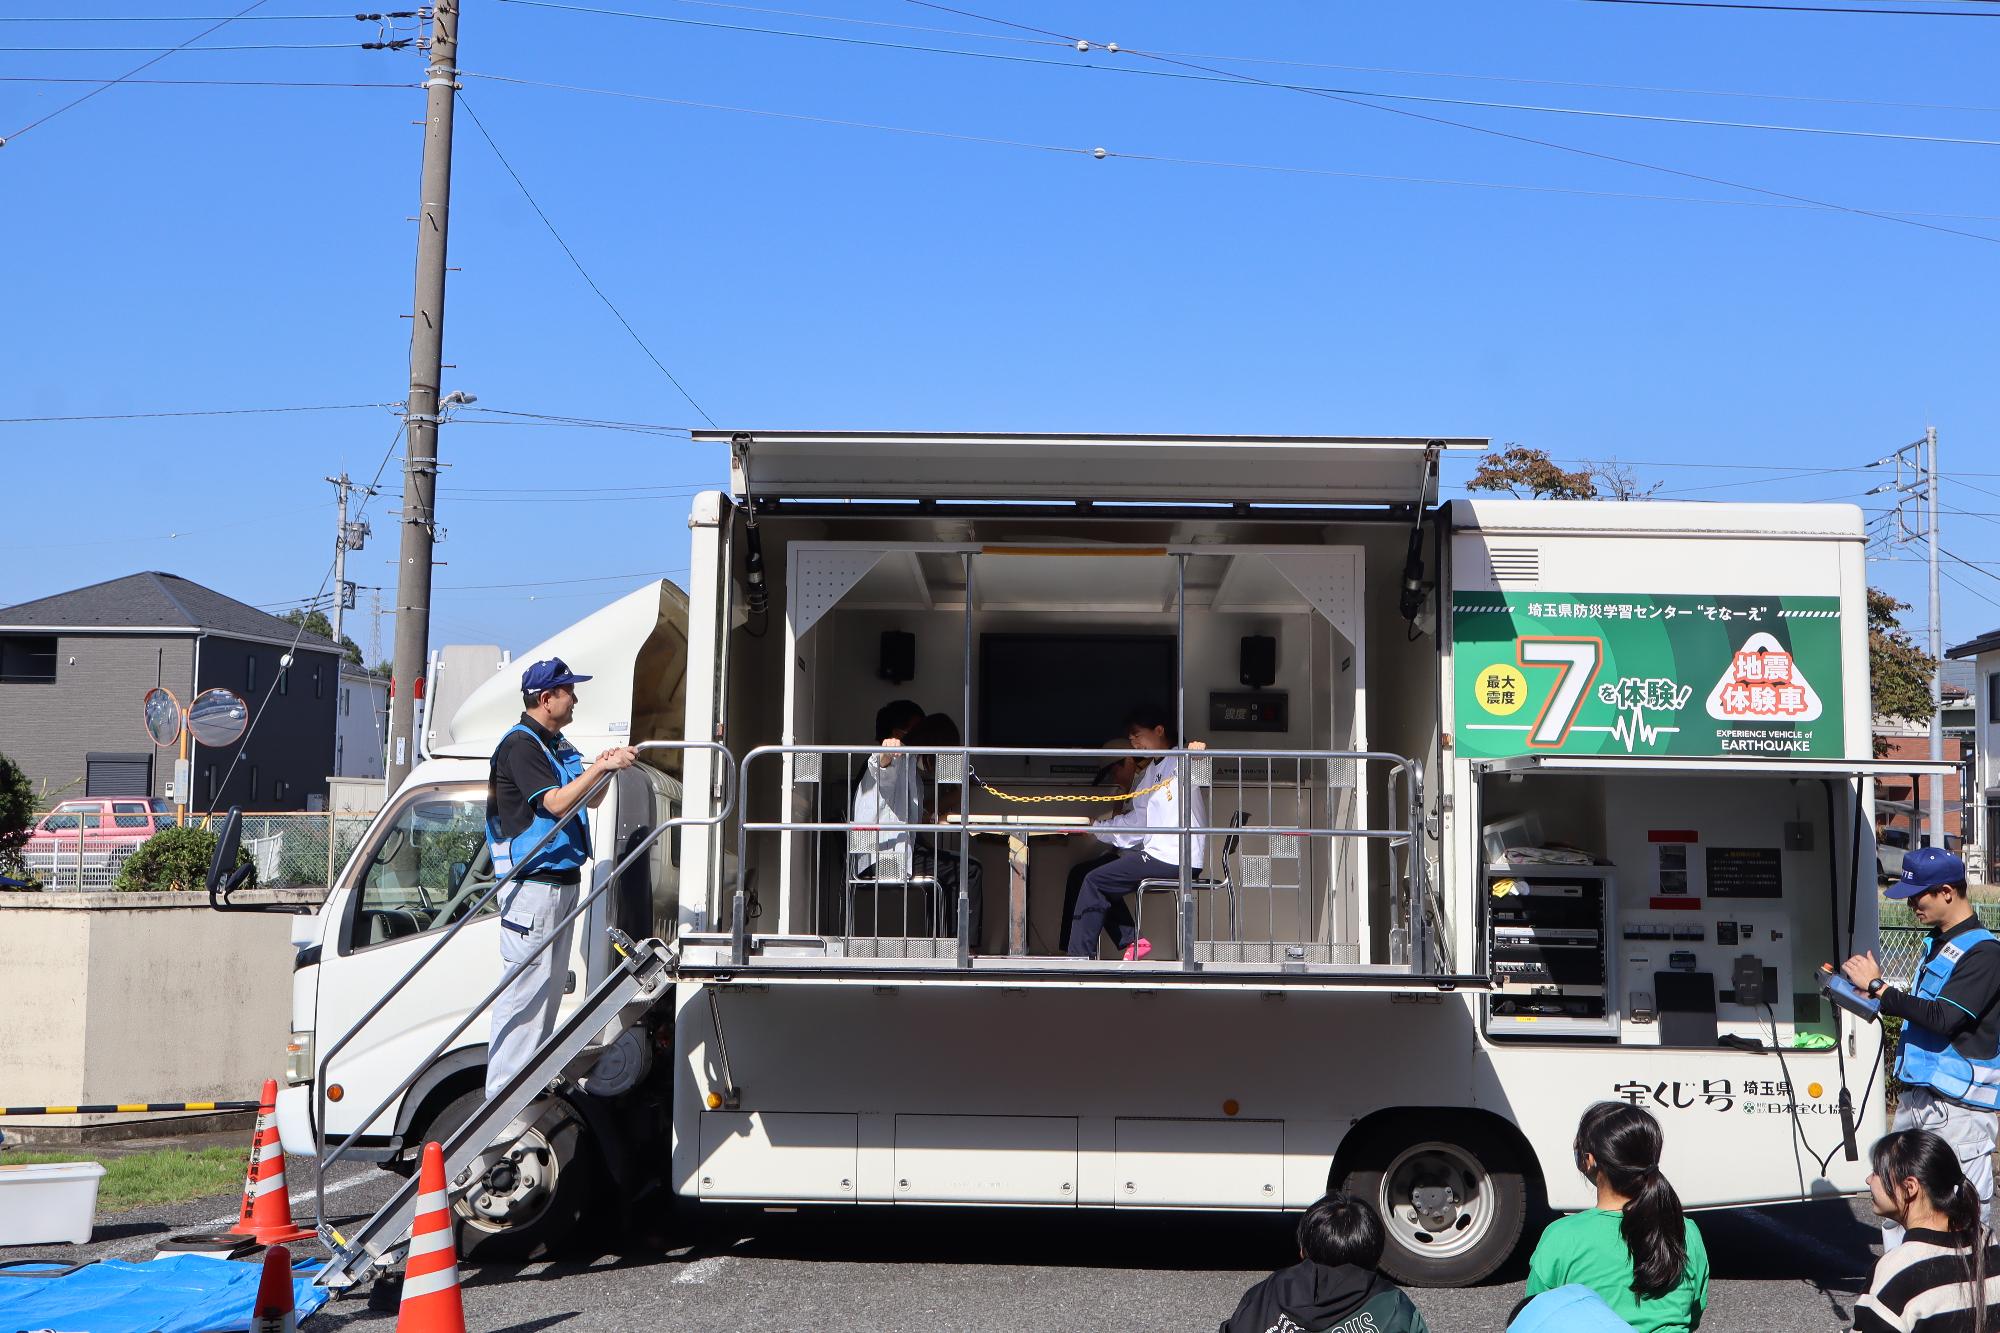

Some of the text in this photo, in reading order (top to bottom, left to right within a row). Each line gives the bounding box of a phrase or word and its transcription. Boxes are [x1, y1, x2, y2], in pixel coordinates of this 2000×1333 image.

[1736, 654, 1790, 681] 地震
[1486, 675, 1515, 689] 最大
[1486, 690, 1515, 704] 震度
[1516, 636, 1603, 747] 7
[1722, 685, 1805, 713] 体験車
[1716, 730, 1767, 738] EXPERIENCE
[1768, 730, 1803, 739] VEHICLE
[1721, 740, 1810, 752] EARTHQUAKE
[1613, 1079, 1737, 1112] 宝くじ号
[1743, 1080, 1790, 1096] 埼玉県
